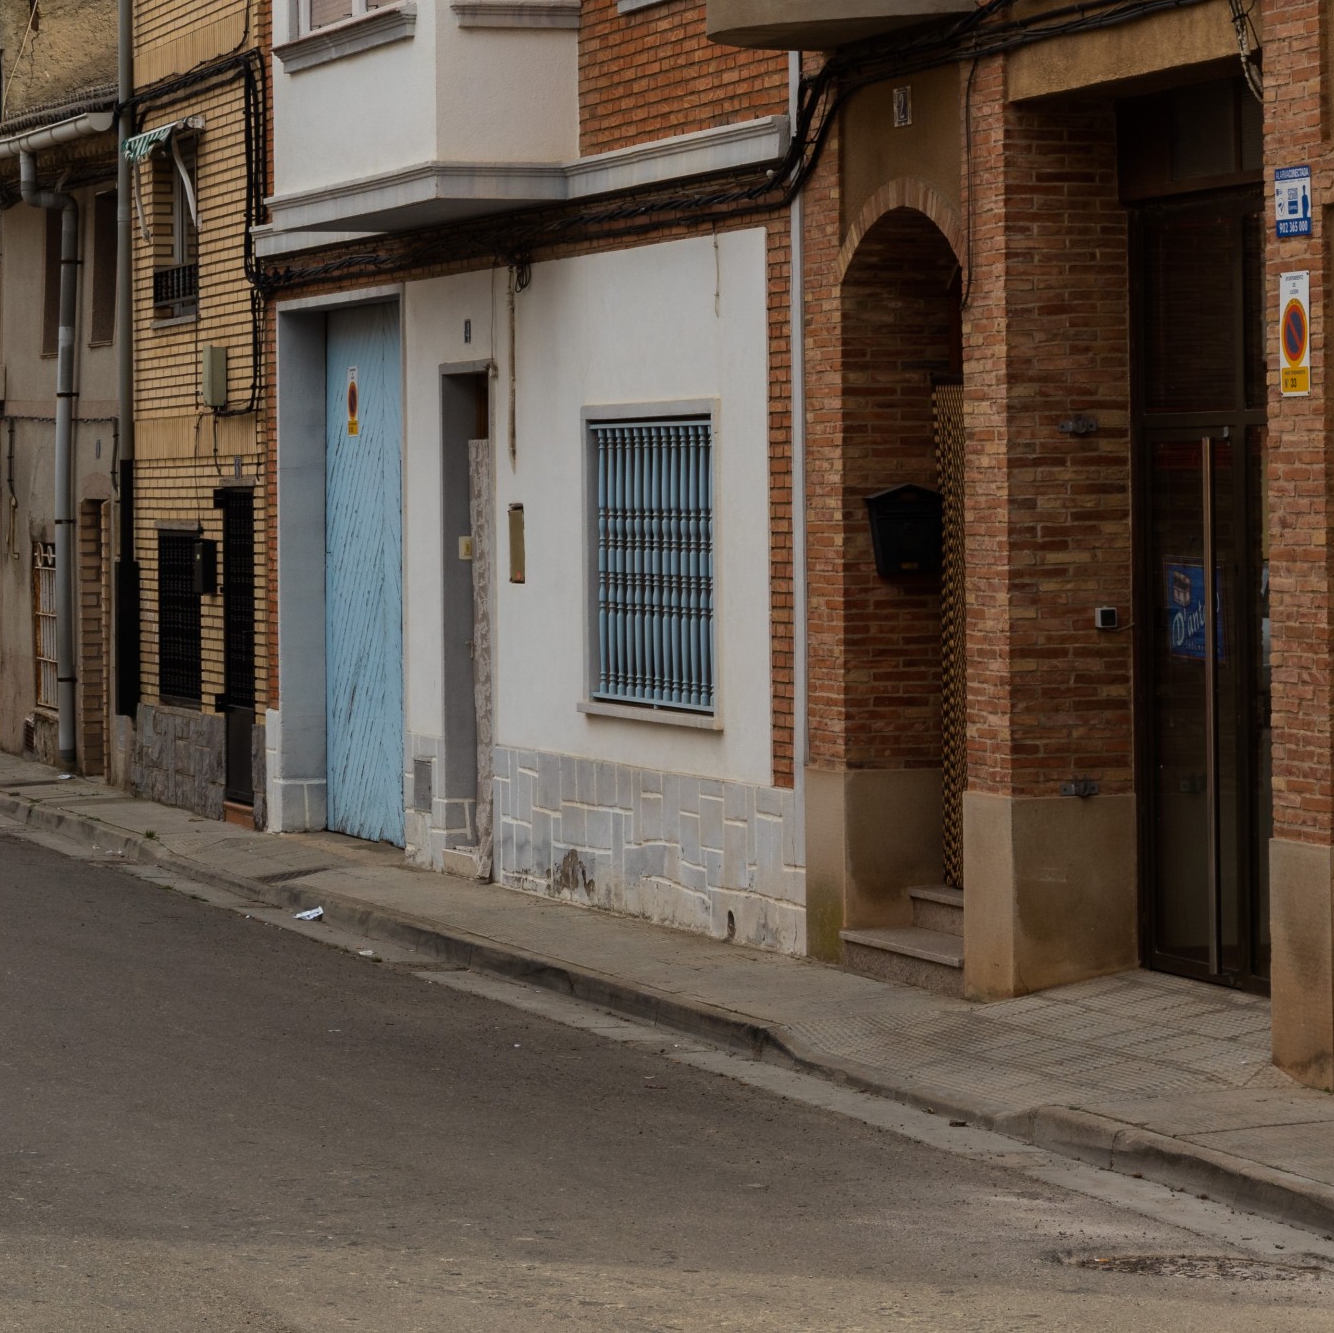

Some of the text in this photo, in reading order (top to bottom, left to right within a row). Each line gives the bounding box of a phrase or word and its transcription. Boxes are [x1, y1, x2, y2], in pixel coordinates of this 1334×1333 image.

[1279, 220, 1308, 234] 902 365 000
